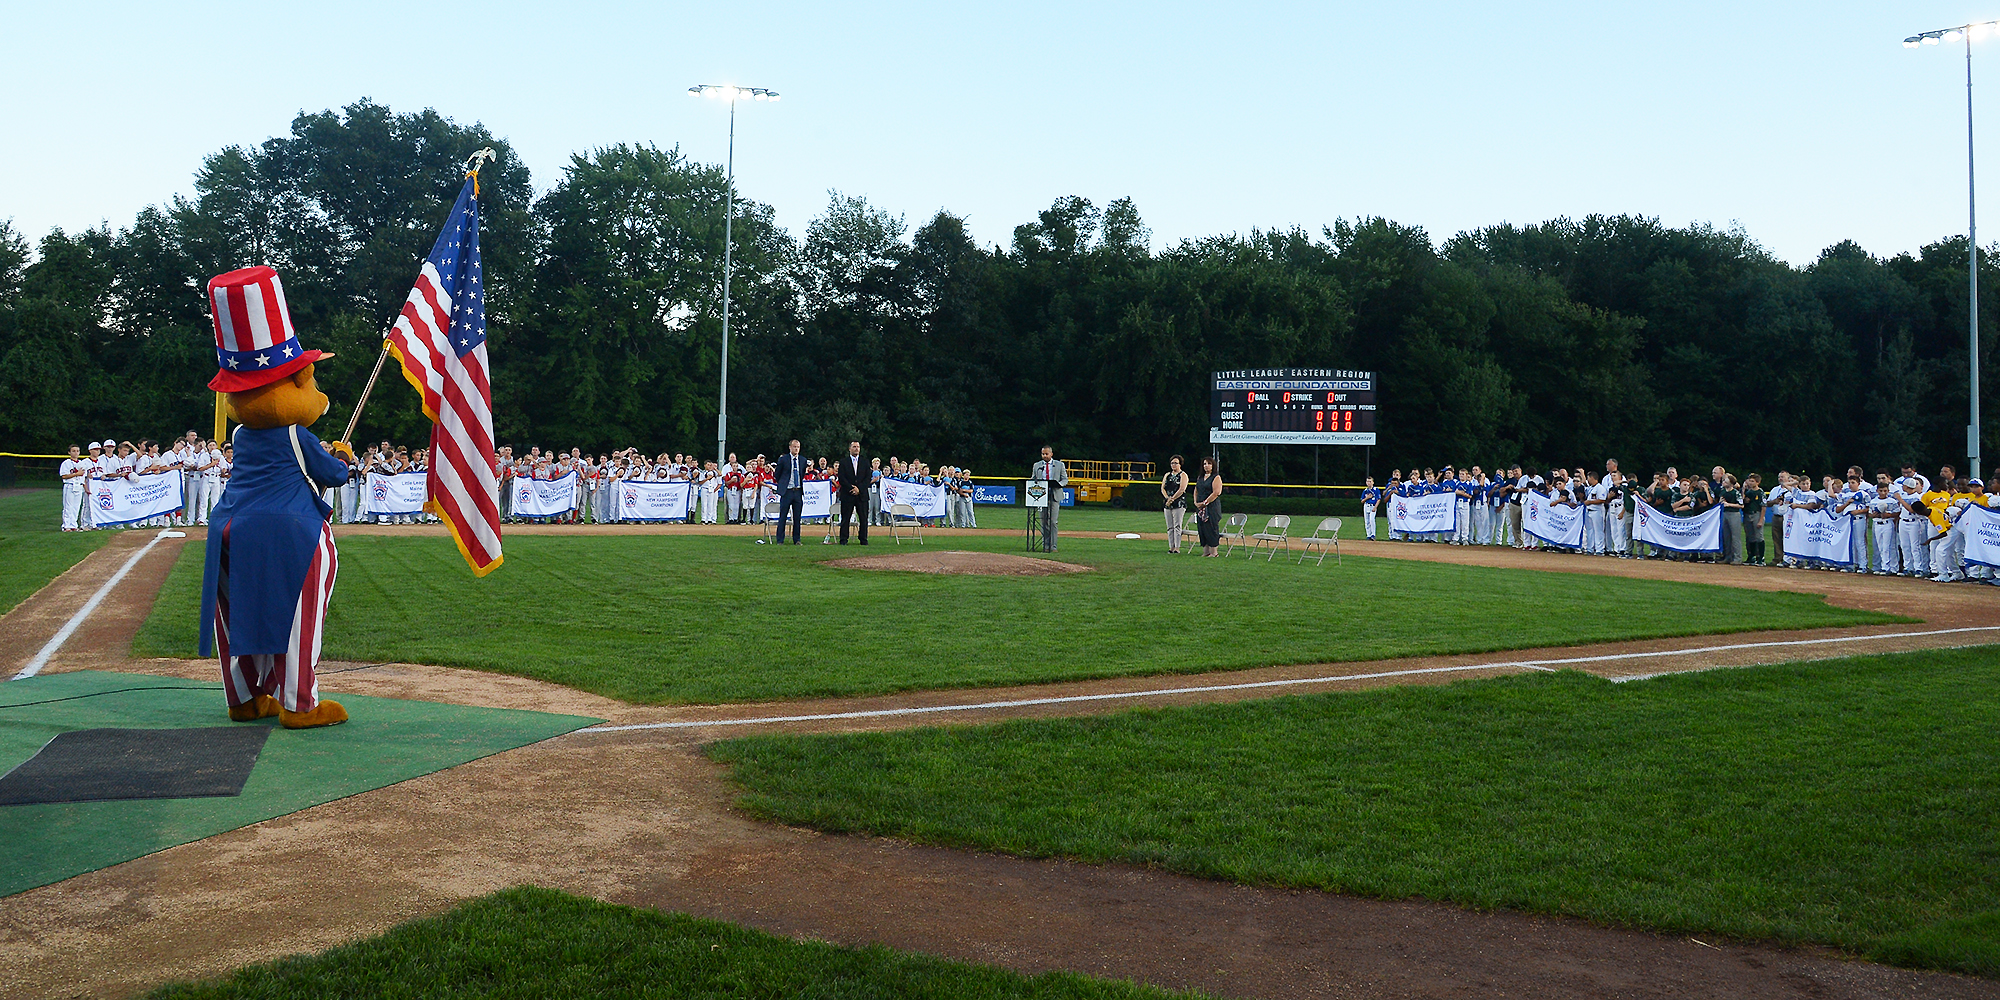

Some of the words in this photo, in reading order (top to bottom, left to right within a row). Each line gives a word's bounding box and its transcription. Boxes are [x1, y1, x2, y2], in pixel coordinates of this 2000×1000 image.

[1217, 370, 1245, 379] LITTLE
[1291, 369, 1331, 377] EASTERN
[1337, 370, 1370, 379] REGION
[1248, 392, 1255, 403] 0
[1283, 392, 1291, 403] 0
[1327, 392, 1335, 403] 0
[1221, 411, 1244, 420] GUEST
[1316, 411, 1324, 421] 0
[1331, 411, 1339, 421] 0
[1345, 411, 1352, 421] 0
[1223, 421, 1244, 429] HOME
[1316, 421, 1323, 431] 0
[1331, 421, 1338, 431] 0
[1344, 421, 1352, 431] 0
[1978, 529, 2000, 538] WASHIN
